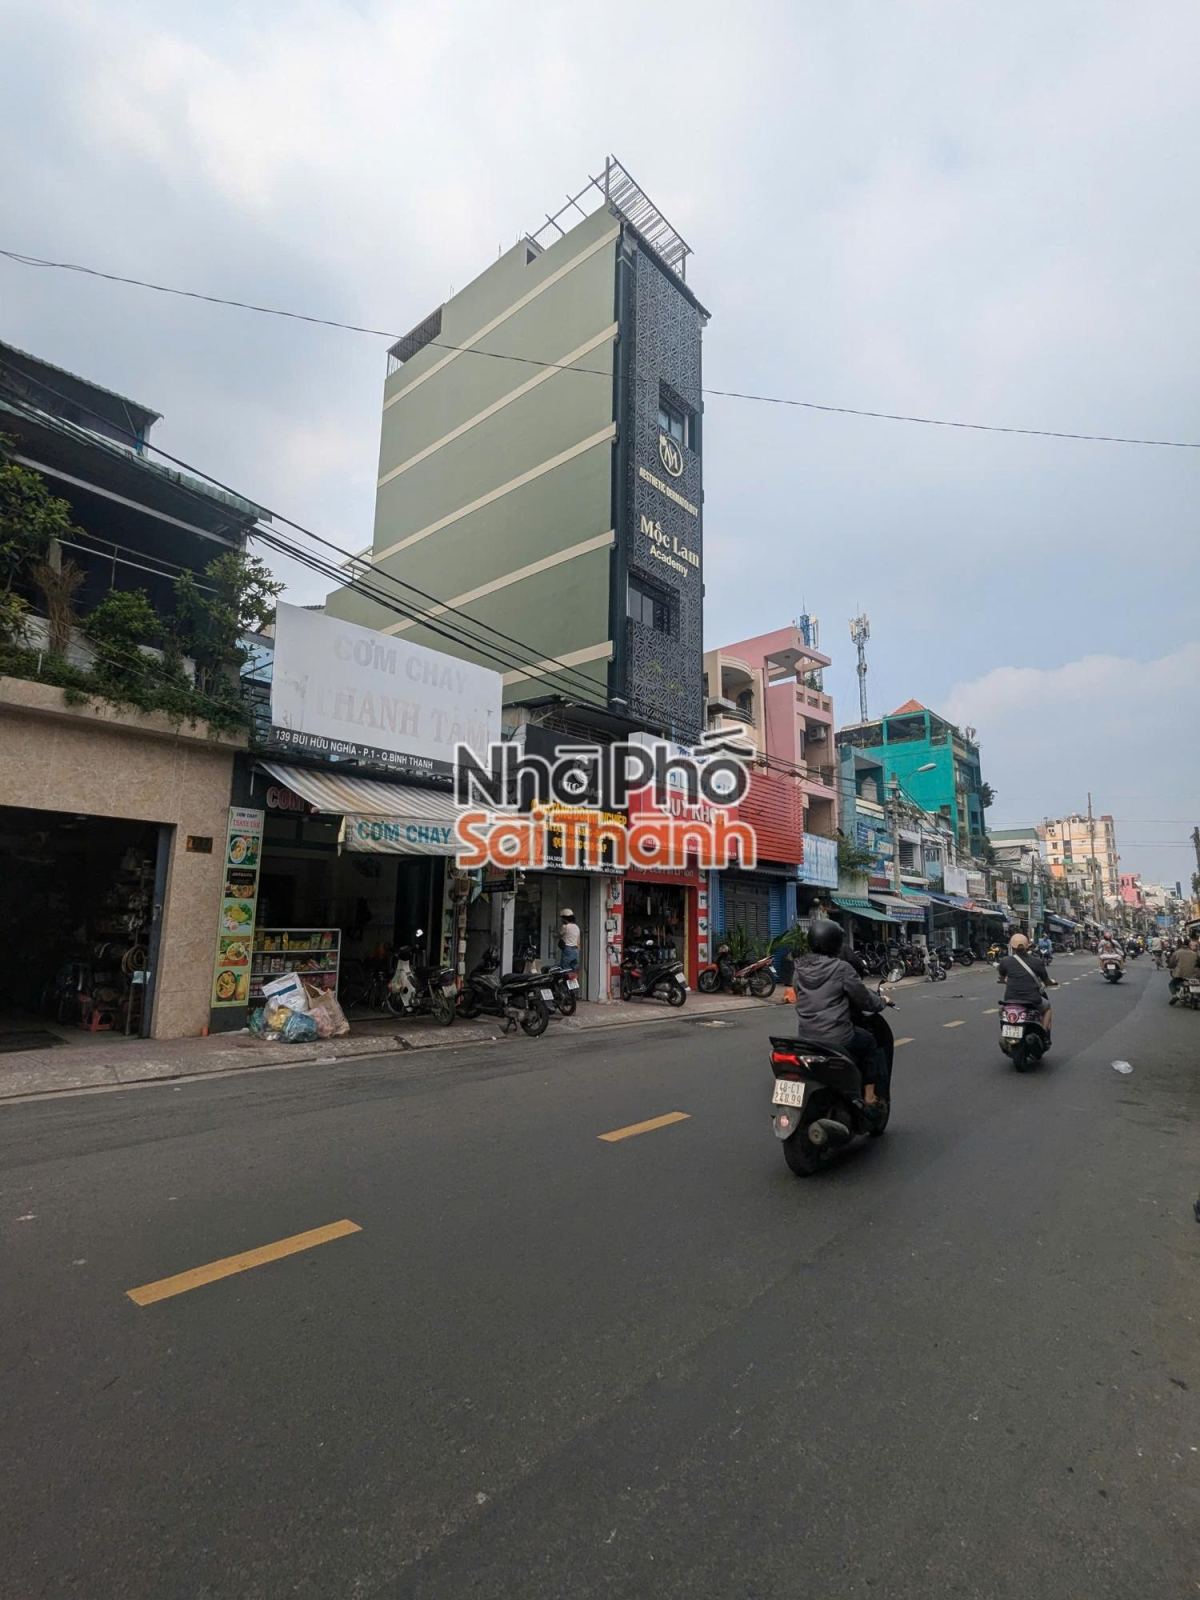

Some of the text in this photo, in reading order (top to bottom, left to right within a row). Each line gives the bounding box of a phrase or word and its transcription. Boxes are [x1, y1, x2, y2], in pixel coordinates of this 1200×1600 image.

[640, 514, 700, 568] Mộc Lam
[650, 545, 688, 577] Academy
[405, 655, 470, 695] CHAY
[275, 730, 291, 742] 139
[292, 732, 308, 746] BÙI
[309, 735, 329, 750] HỮU
[330, 741, 357, 755] NGHĨA
[363, 747, 375, 759] P.1
[381, 751, 408, 765] Q.BÌNH
[357, 820, 451, 844] CƠM CHAY
